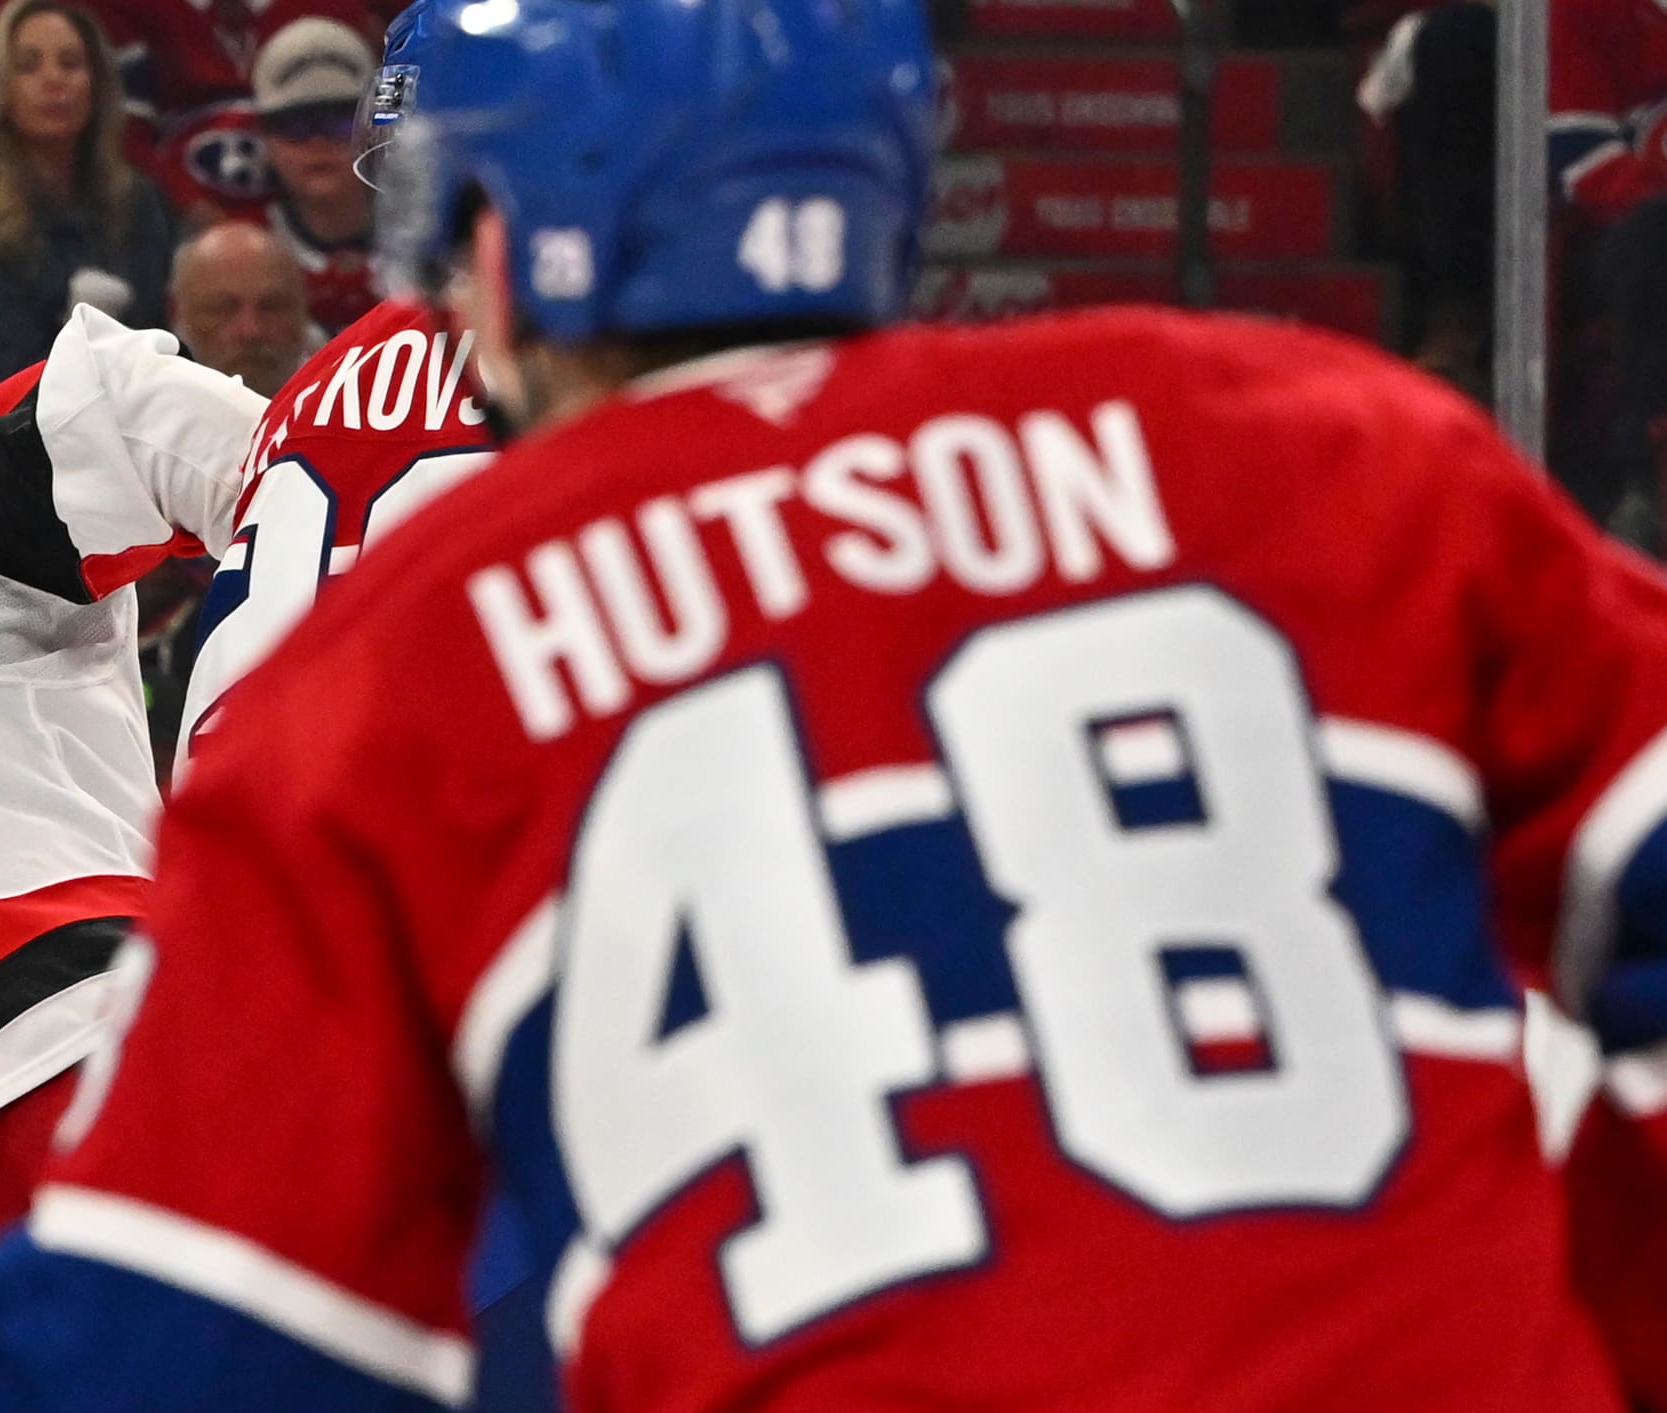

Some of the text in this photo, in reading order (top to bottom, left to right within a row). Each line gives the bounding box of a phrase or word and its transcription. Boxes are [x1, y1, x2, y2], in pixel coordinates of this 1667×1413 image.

[736, 196, 845, 290] 48
[468, 397, 1177, 741] HUTSON
[550, 580, 1414, 1351] 48
